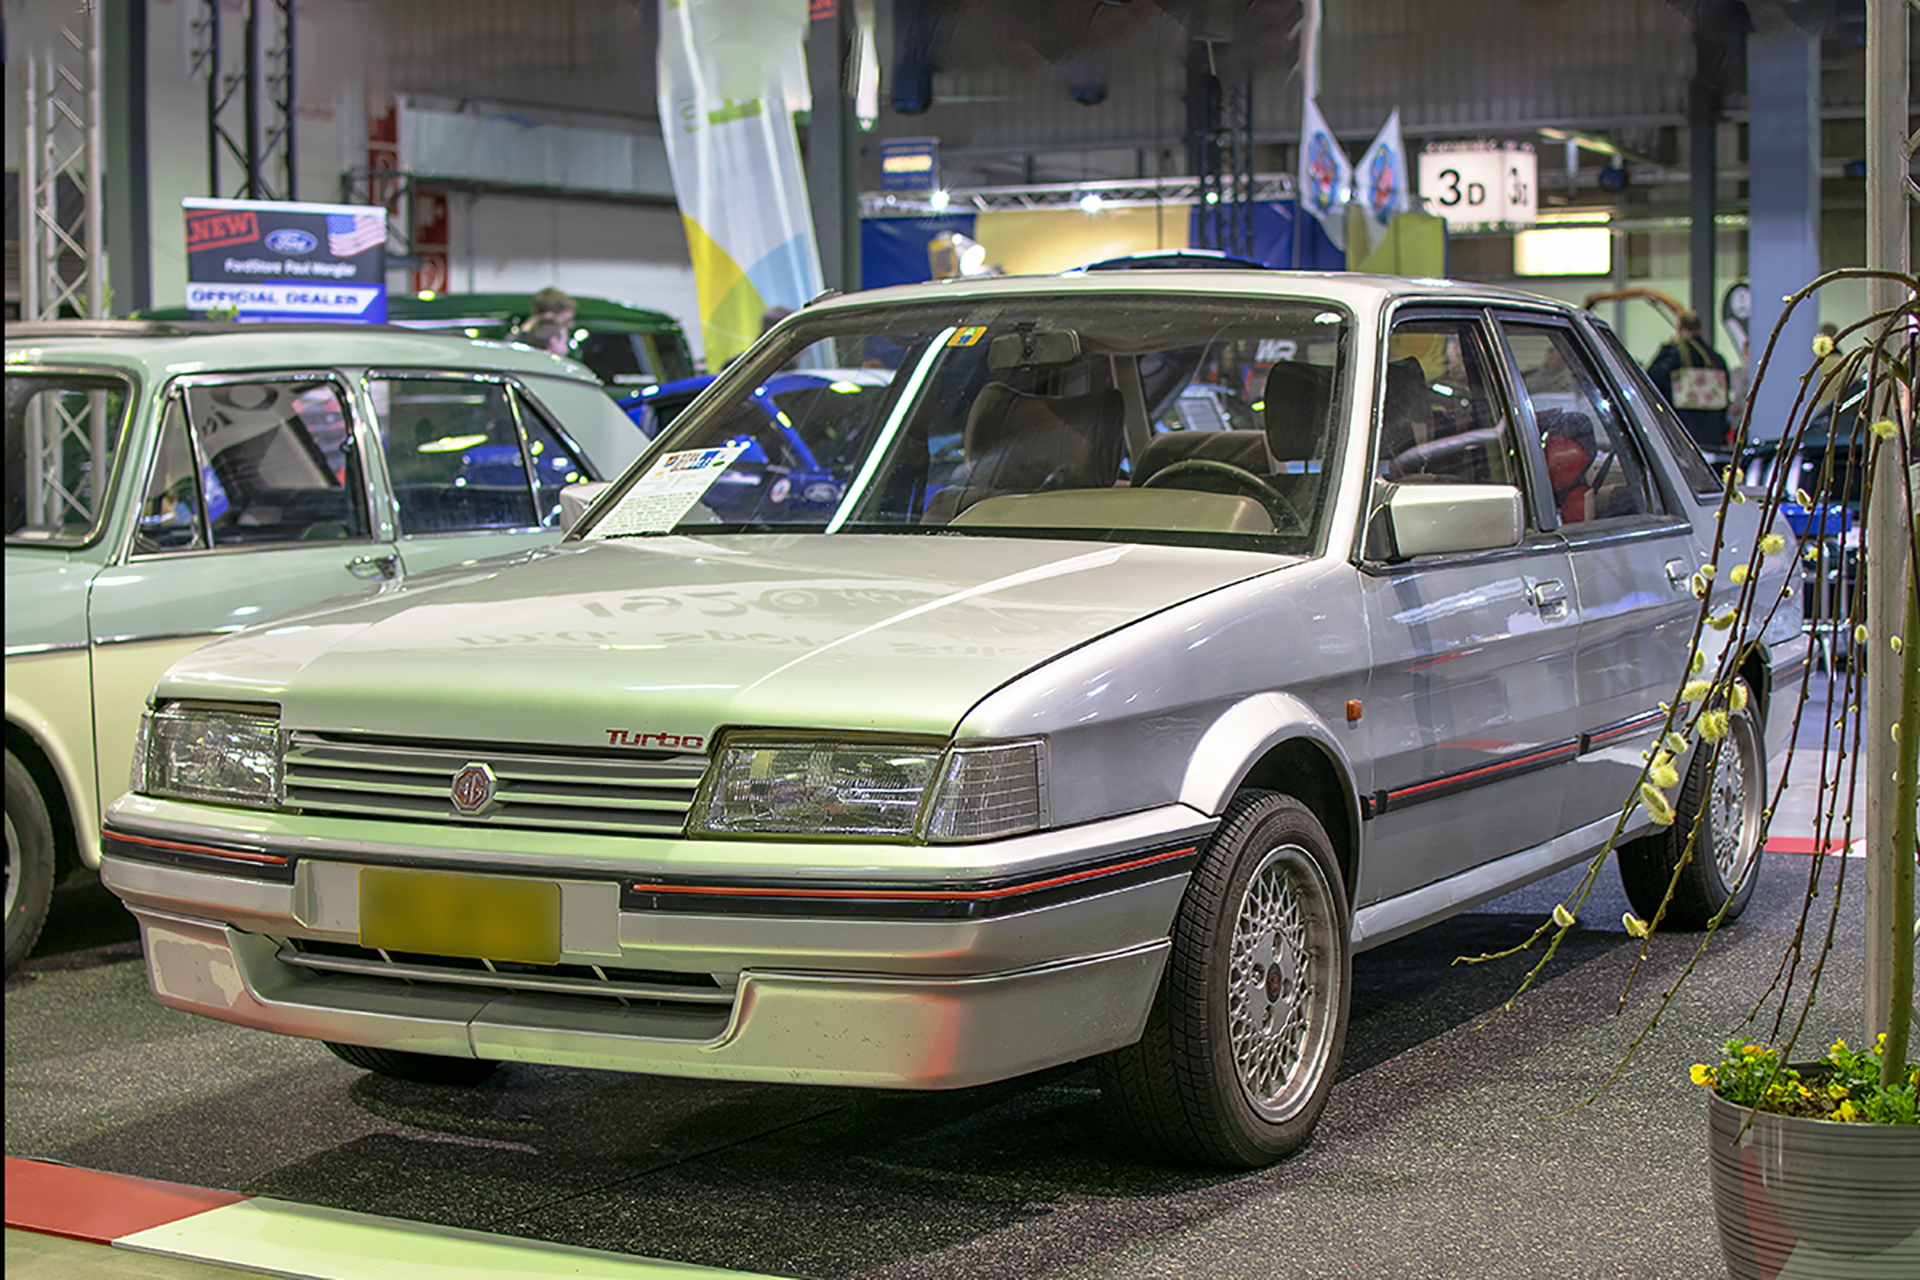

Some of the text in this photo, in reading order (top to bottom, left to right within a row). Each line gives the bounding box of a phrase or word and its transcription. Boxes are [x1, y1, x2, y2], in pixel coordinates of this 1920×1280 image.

[1438, 168, 1486, 207] 3D
[188, 211, 250, 242] NEW
[223, 257, 282, 275] FordStore
[283, 258, 310, 276] Paul
[191, 289, 358, 306] OFFICIAL DEALER
[605, 728, 704, 750] Turbo
[456, 771, 486, 804] MG
